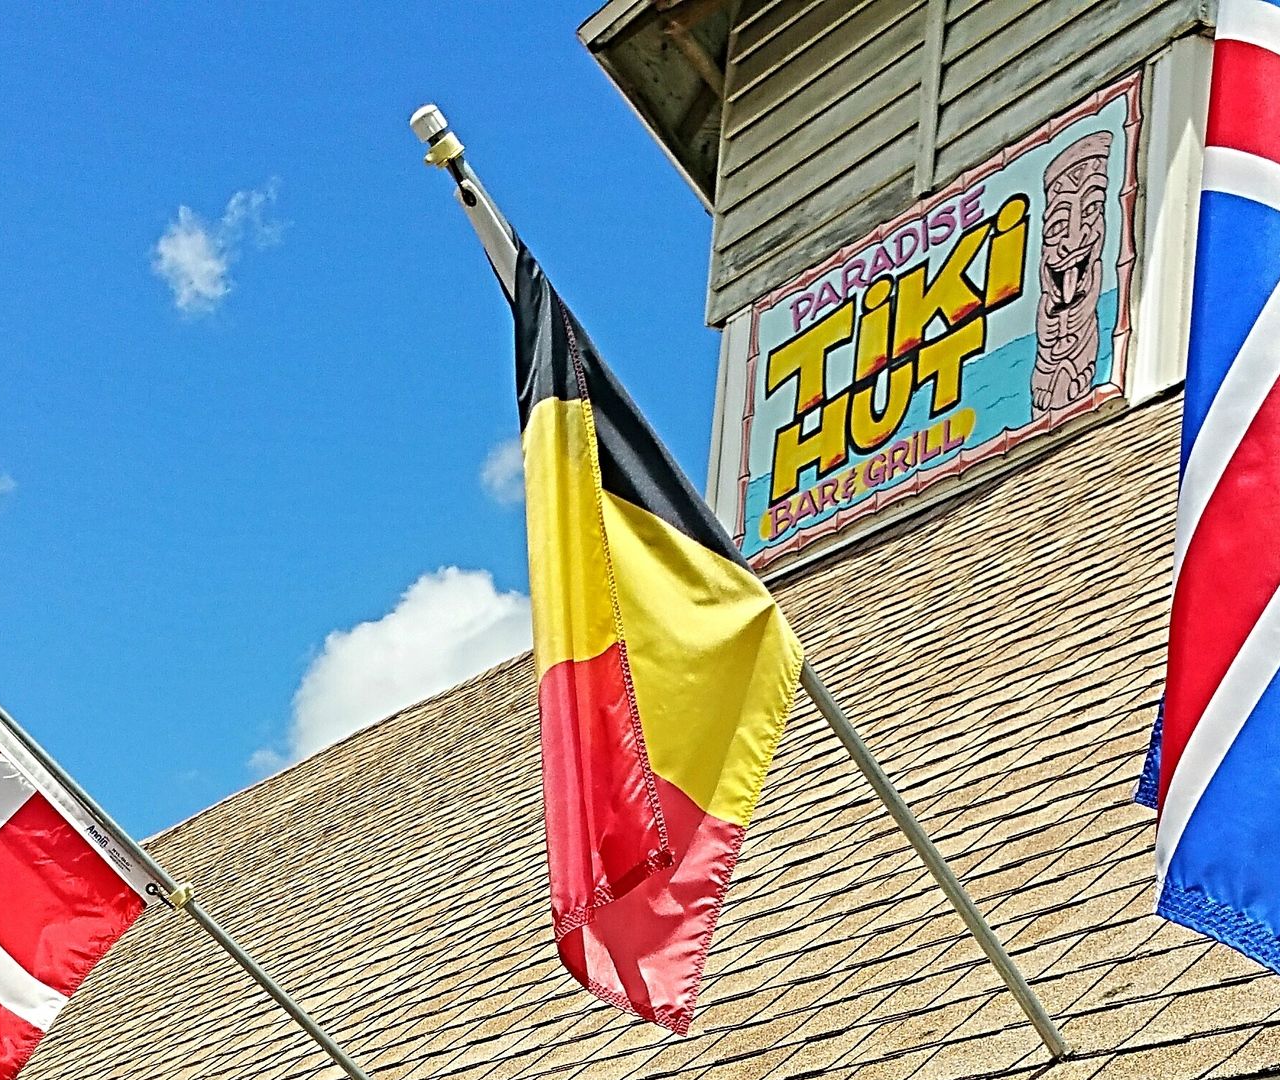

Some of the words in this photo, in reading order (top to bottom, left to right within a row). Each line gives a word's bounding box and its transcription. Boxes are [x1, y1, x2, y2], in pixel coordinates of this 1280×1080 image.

[790, 185, 986, 332] PARADISE
[769, 315, 987, 507] HUT
[768, 478, 838, 541] BAR
[85, 824, 110, 850] Annin
